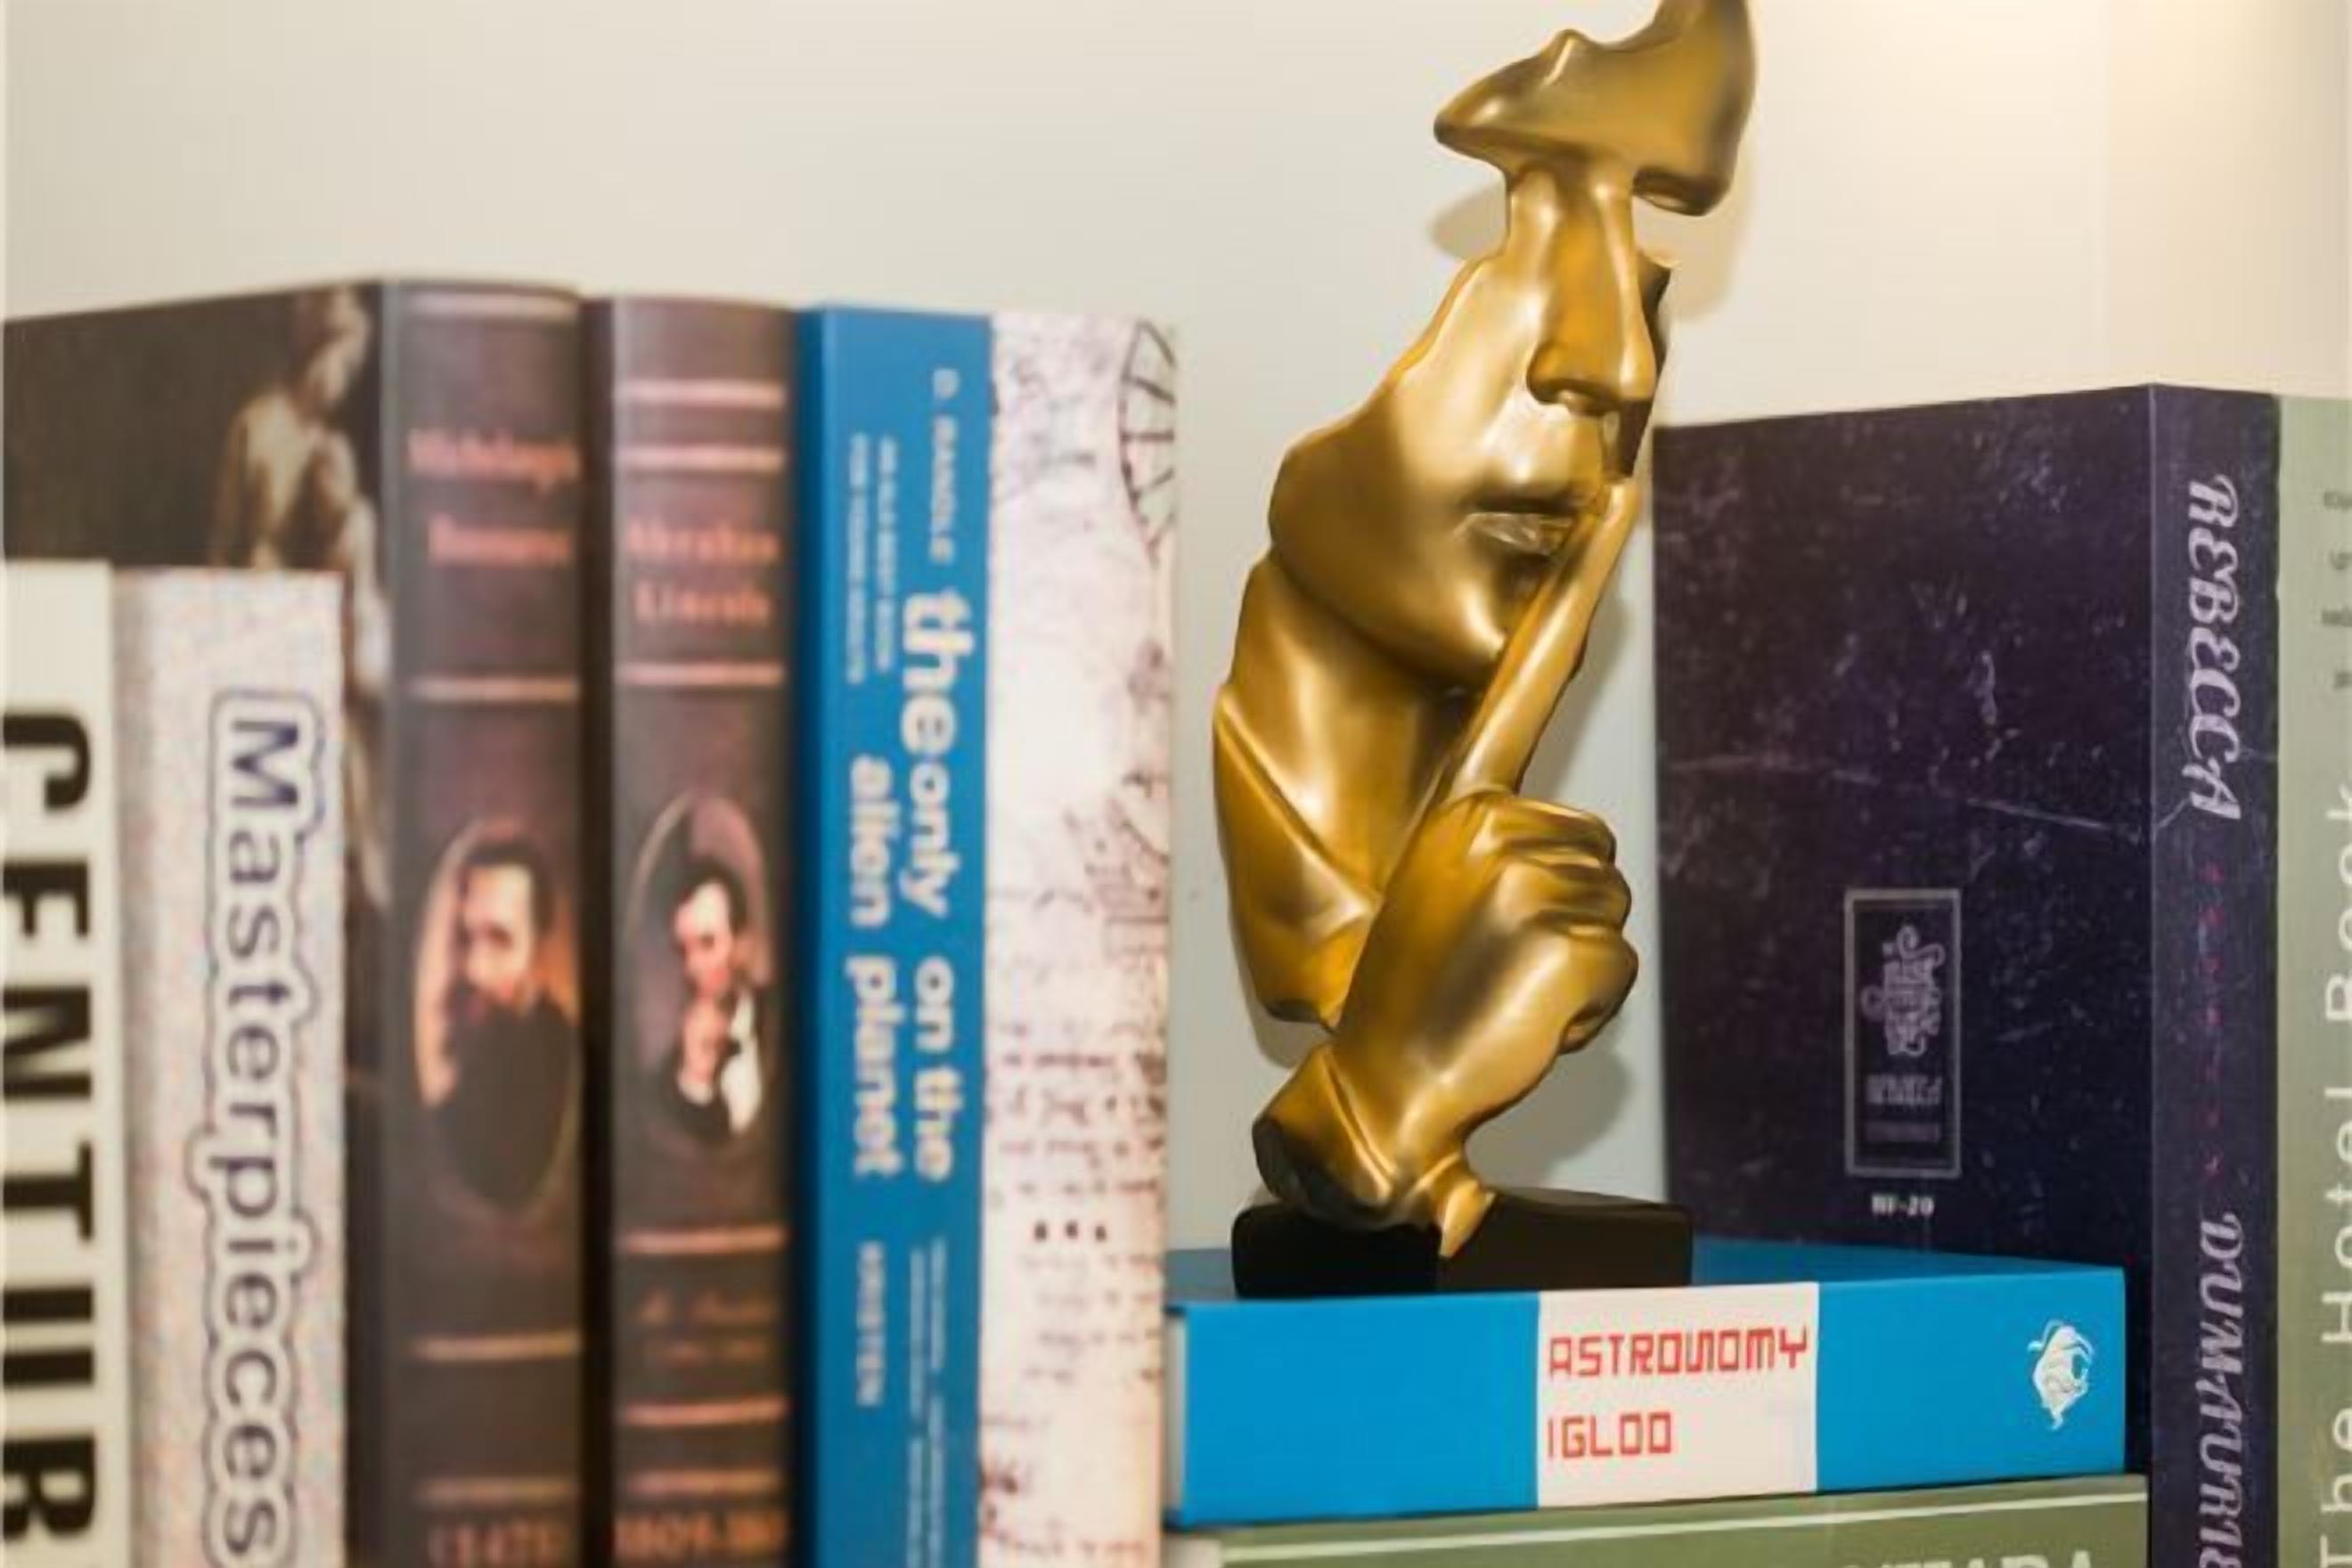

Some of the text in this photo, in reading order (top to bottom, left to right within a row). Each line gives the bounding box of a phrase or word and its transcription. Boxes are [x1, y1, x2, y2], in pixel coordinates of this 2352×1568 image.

[2182, 473, 2242, 821] REBECCA
[845, 754, 905, 1182] alien planet
[899, 586, 976, 1182] the only on the
[208, 716, 301, 1559] Masterpieces
[1547, 1325, 1809, 1376] ASTRONOMY
[1547, 1412, 1673, 1458] IGLOO
